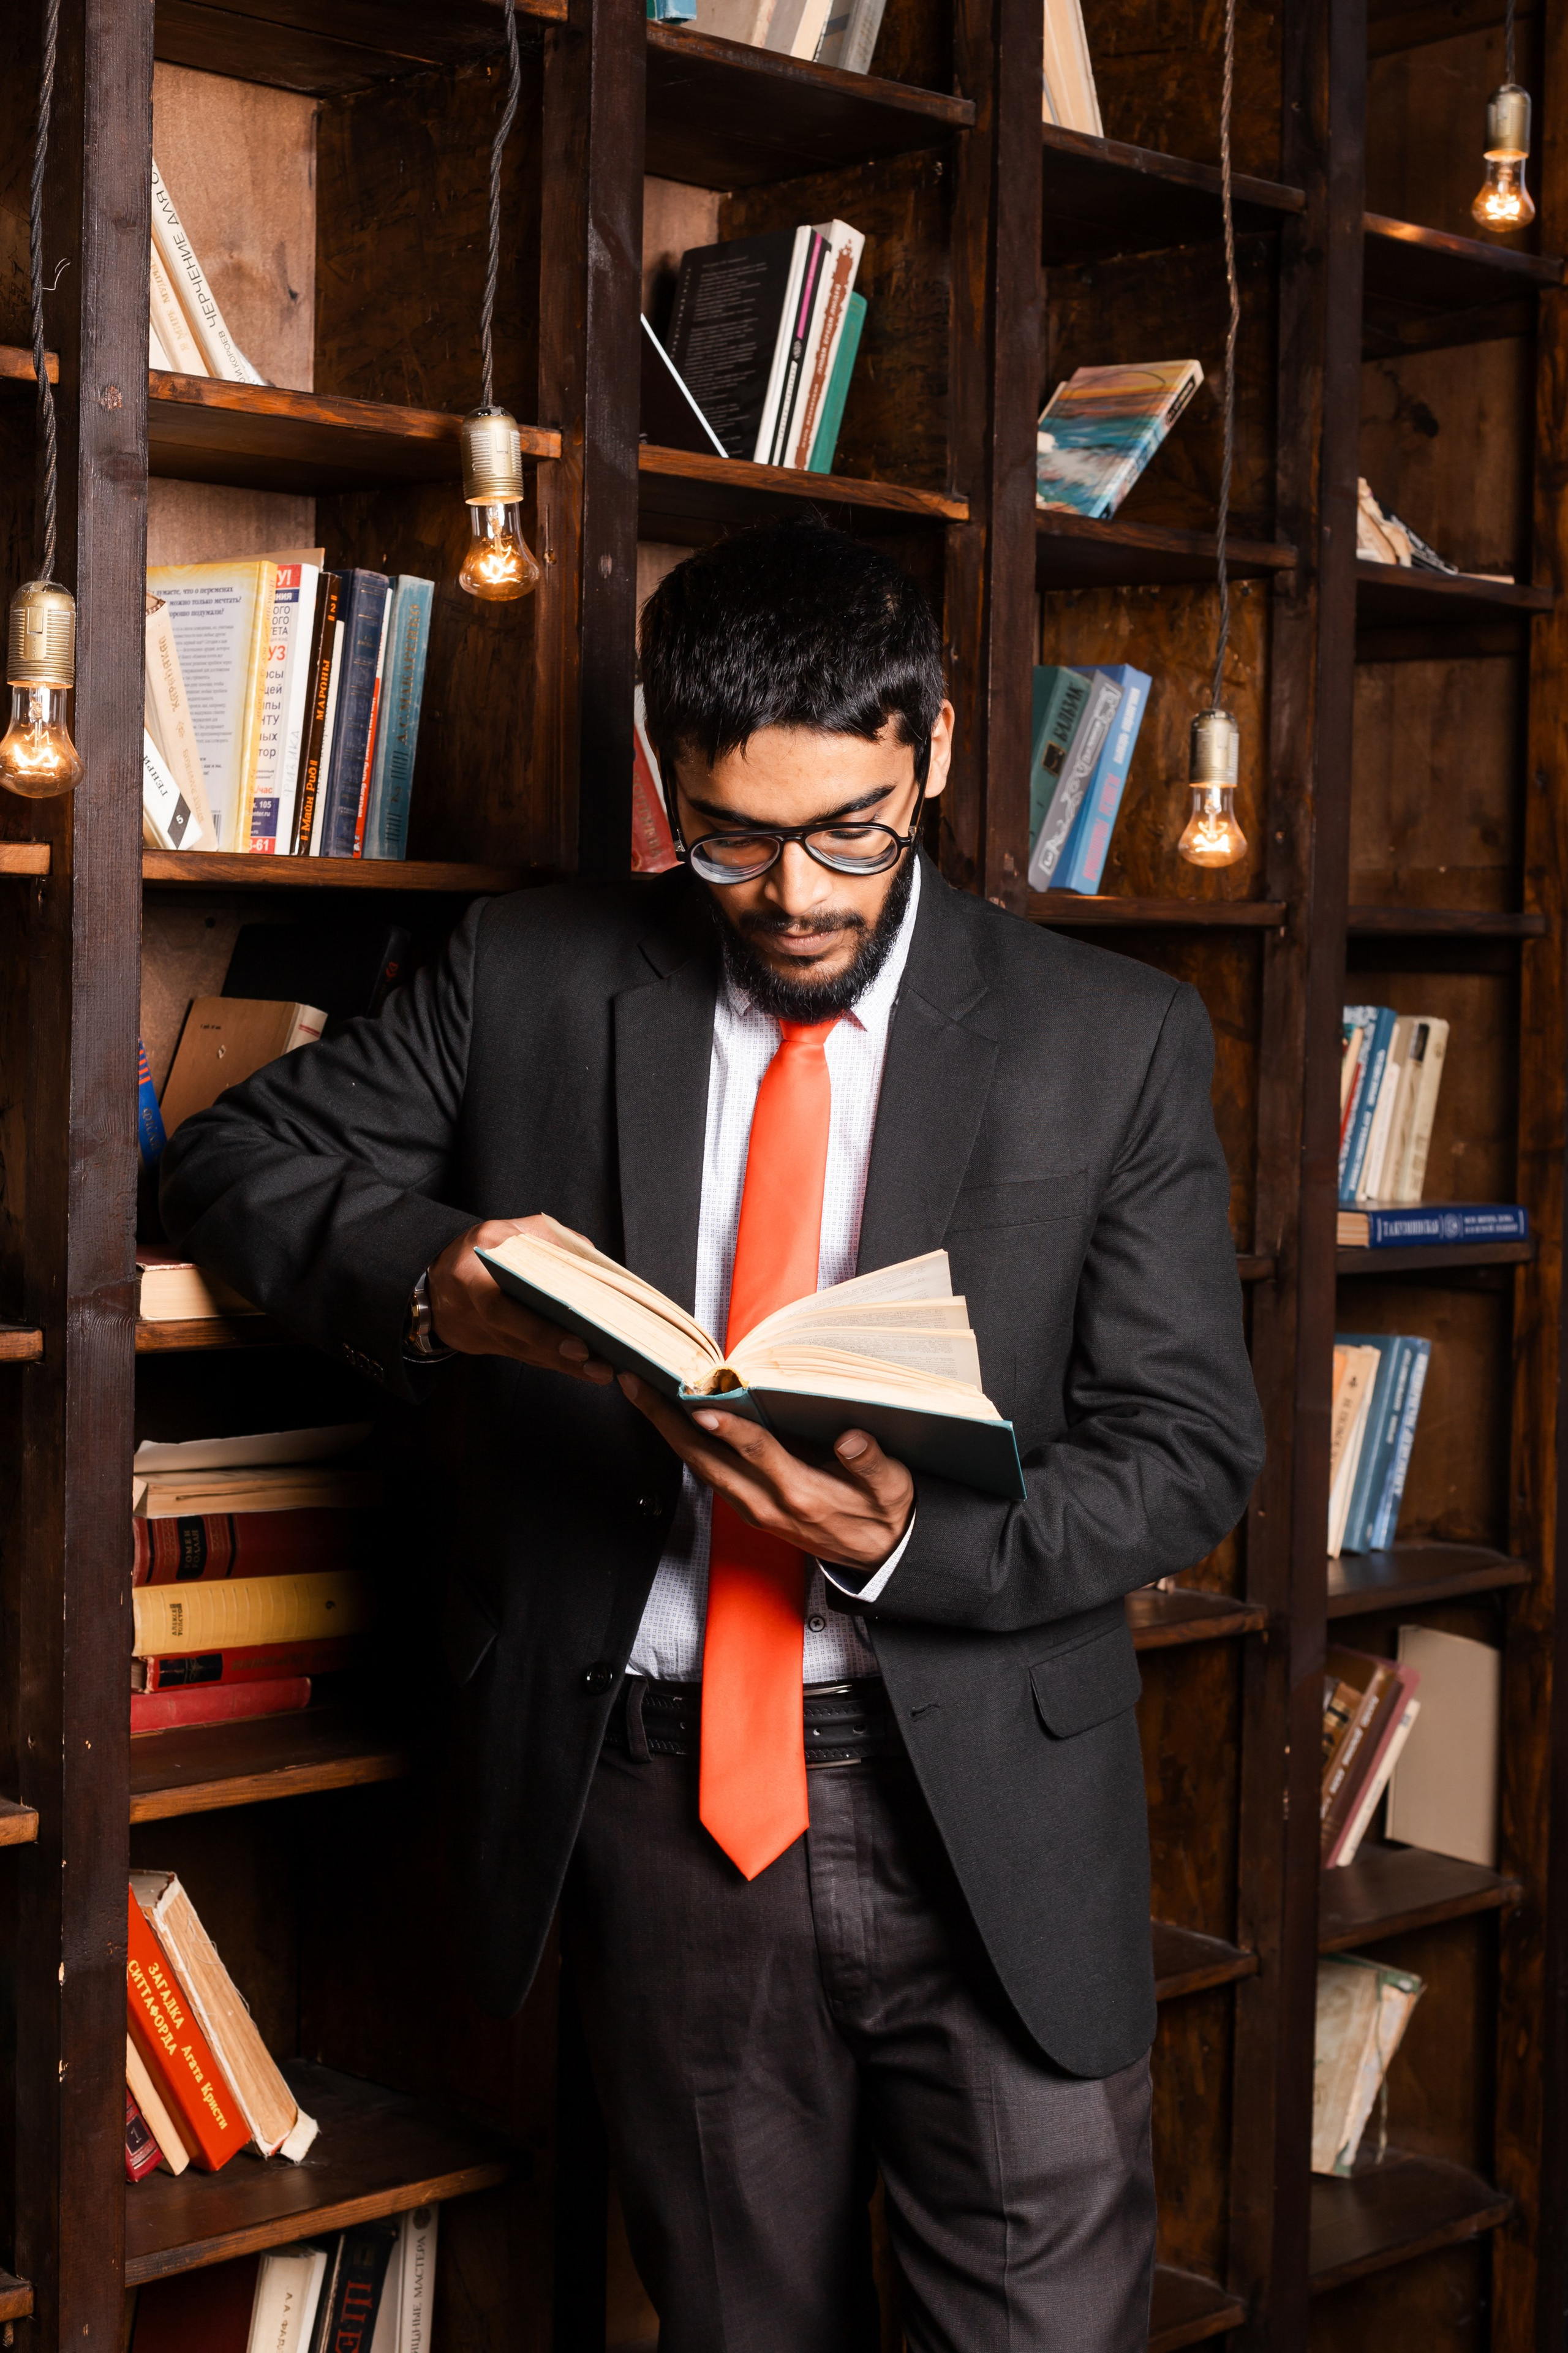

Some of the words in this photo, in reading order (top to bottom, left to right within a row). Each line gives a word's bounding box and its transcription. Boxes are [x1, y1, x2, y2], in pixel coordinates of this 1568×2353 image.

[156, 190, 179, 226] ДЛЯ
[173, 231, 216, 328] ЧЕРЧЕНИЕ
[200, 586, 233, 595] переменах
[330, 603, 337, 613] 2
[191, 608, 224, 617] подумали?
[272, 616, 290, 625] ОГО
[273, 606, 290, 614] ОГО
[315, 659, 331, 721] МАРОНЫ
[283, 729, 301, 798] ФИЗИКА
[307, 765, 317, 792] Рид
[175, 815, 184, 825] 5
[301, 793, 314, 833] Майн
[184, 1529, 192, 1569] РОМЕН
[191, 1528, 201, 1569] РОЛЛАН
[175, 1602, 184, 1637] ТОЛСТОЙ
[127, 1958, 178, 2057] СИТТАФОРДА
[148, 1961, 186, 2031] ЗАГАДКА
[181, 2044, 205, 2084] Агата
[200, 2082, 228, 2131] Кристи
[131, 2127, 143, 2145] 1
[413, 2235, 427, 2298] МАСТЕРА
